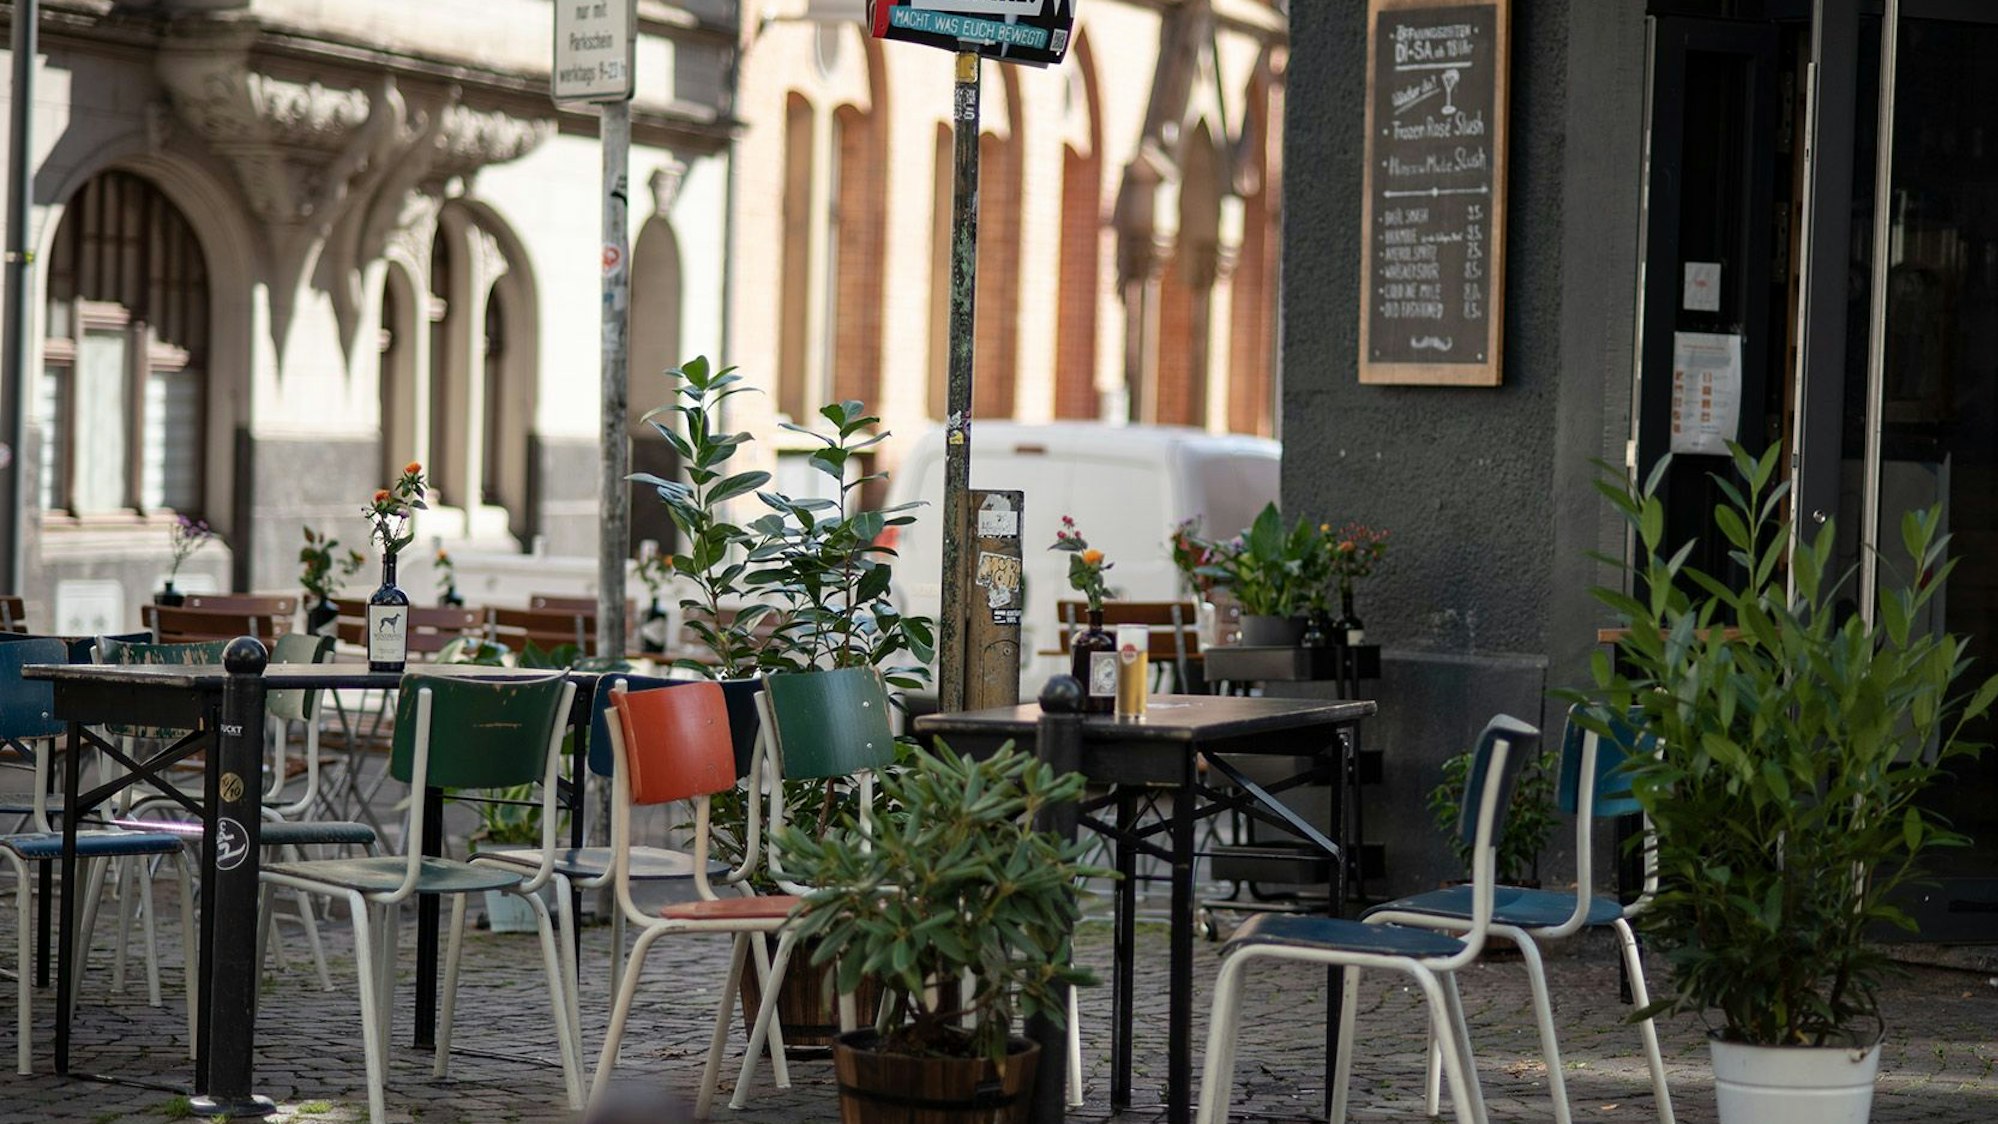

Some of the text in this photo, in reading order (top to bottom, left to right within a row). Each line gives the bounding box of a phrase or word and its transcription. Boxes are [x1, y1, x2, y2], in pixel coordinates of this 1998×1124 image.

[576, 2, 607, 19] nur mit
[569, 30, 613, 51] Parkschein
[935, 16, 958, 34] WAS
[964, 20, 995, 38] EUCH
[998, 26, 1045, 46] BEWEGT!
[560, 65, 596, 86] werktags
[1454, 110, 1485, 137] Slush
[1454, 146, 1486, 171] Slush
